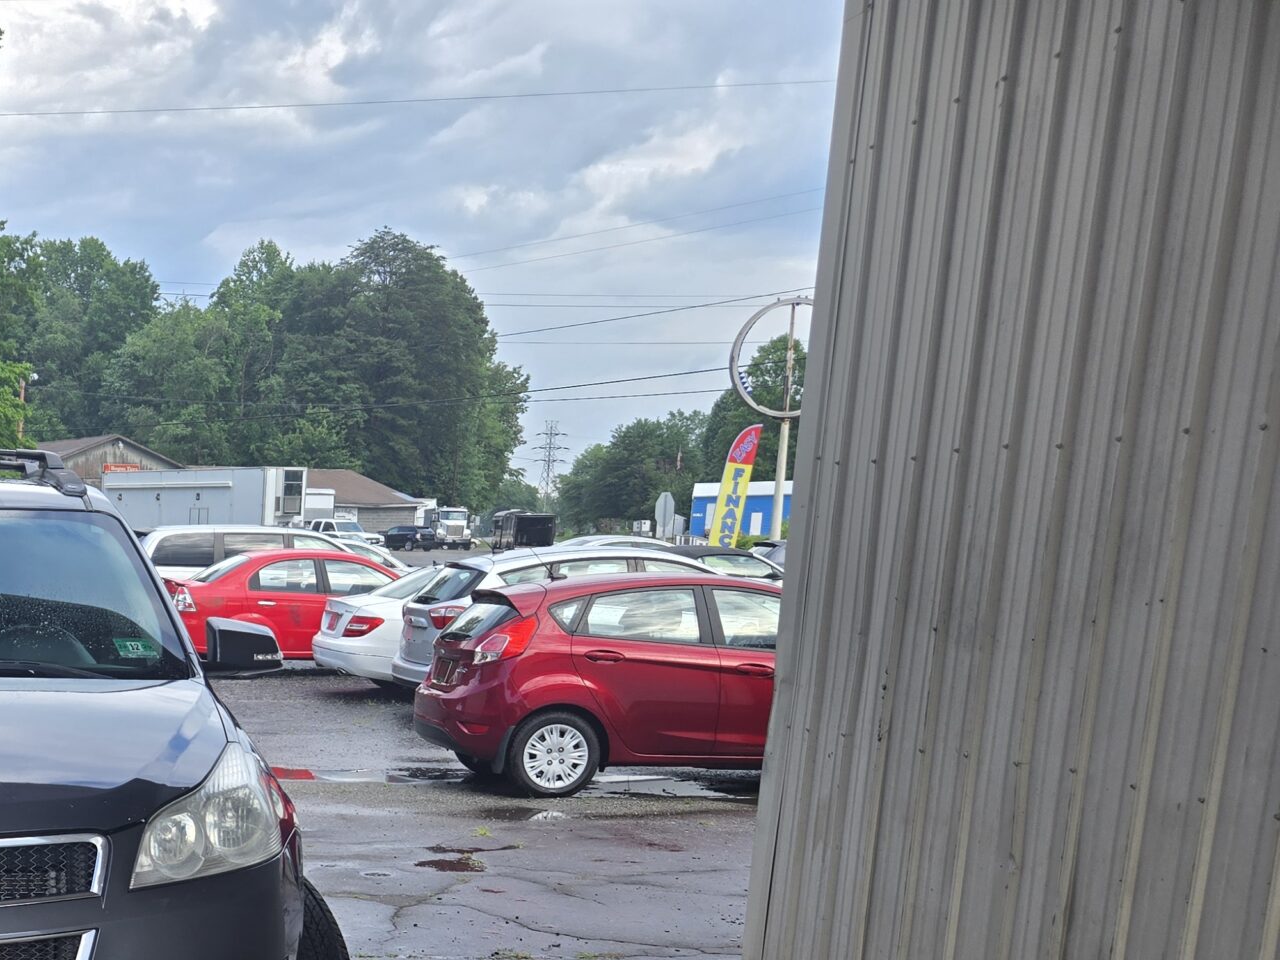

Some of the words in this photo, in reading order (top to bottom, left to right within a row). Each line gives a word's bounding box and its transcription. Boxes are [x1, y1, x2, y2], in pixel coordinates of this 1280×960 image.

[733, 430, 758, 462] EASY
[718, 467, 746, 549] FINANC
[129, 643, 140, 651] 12
